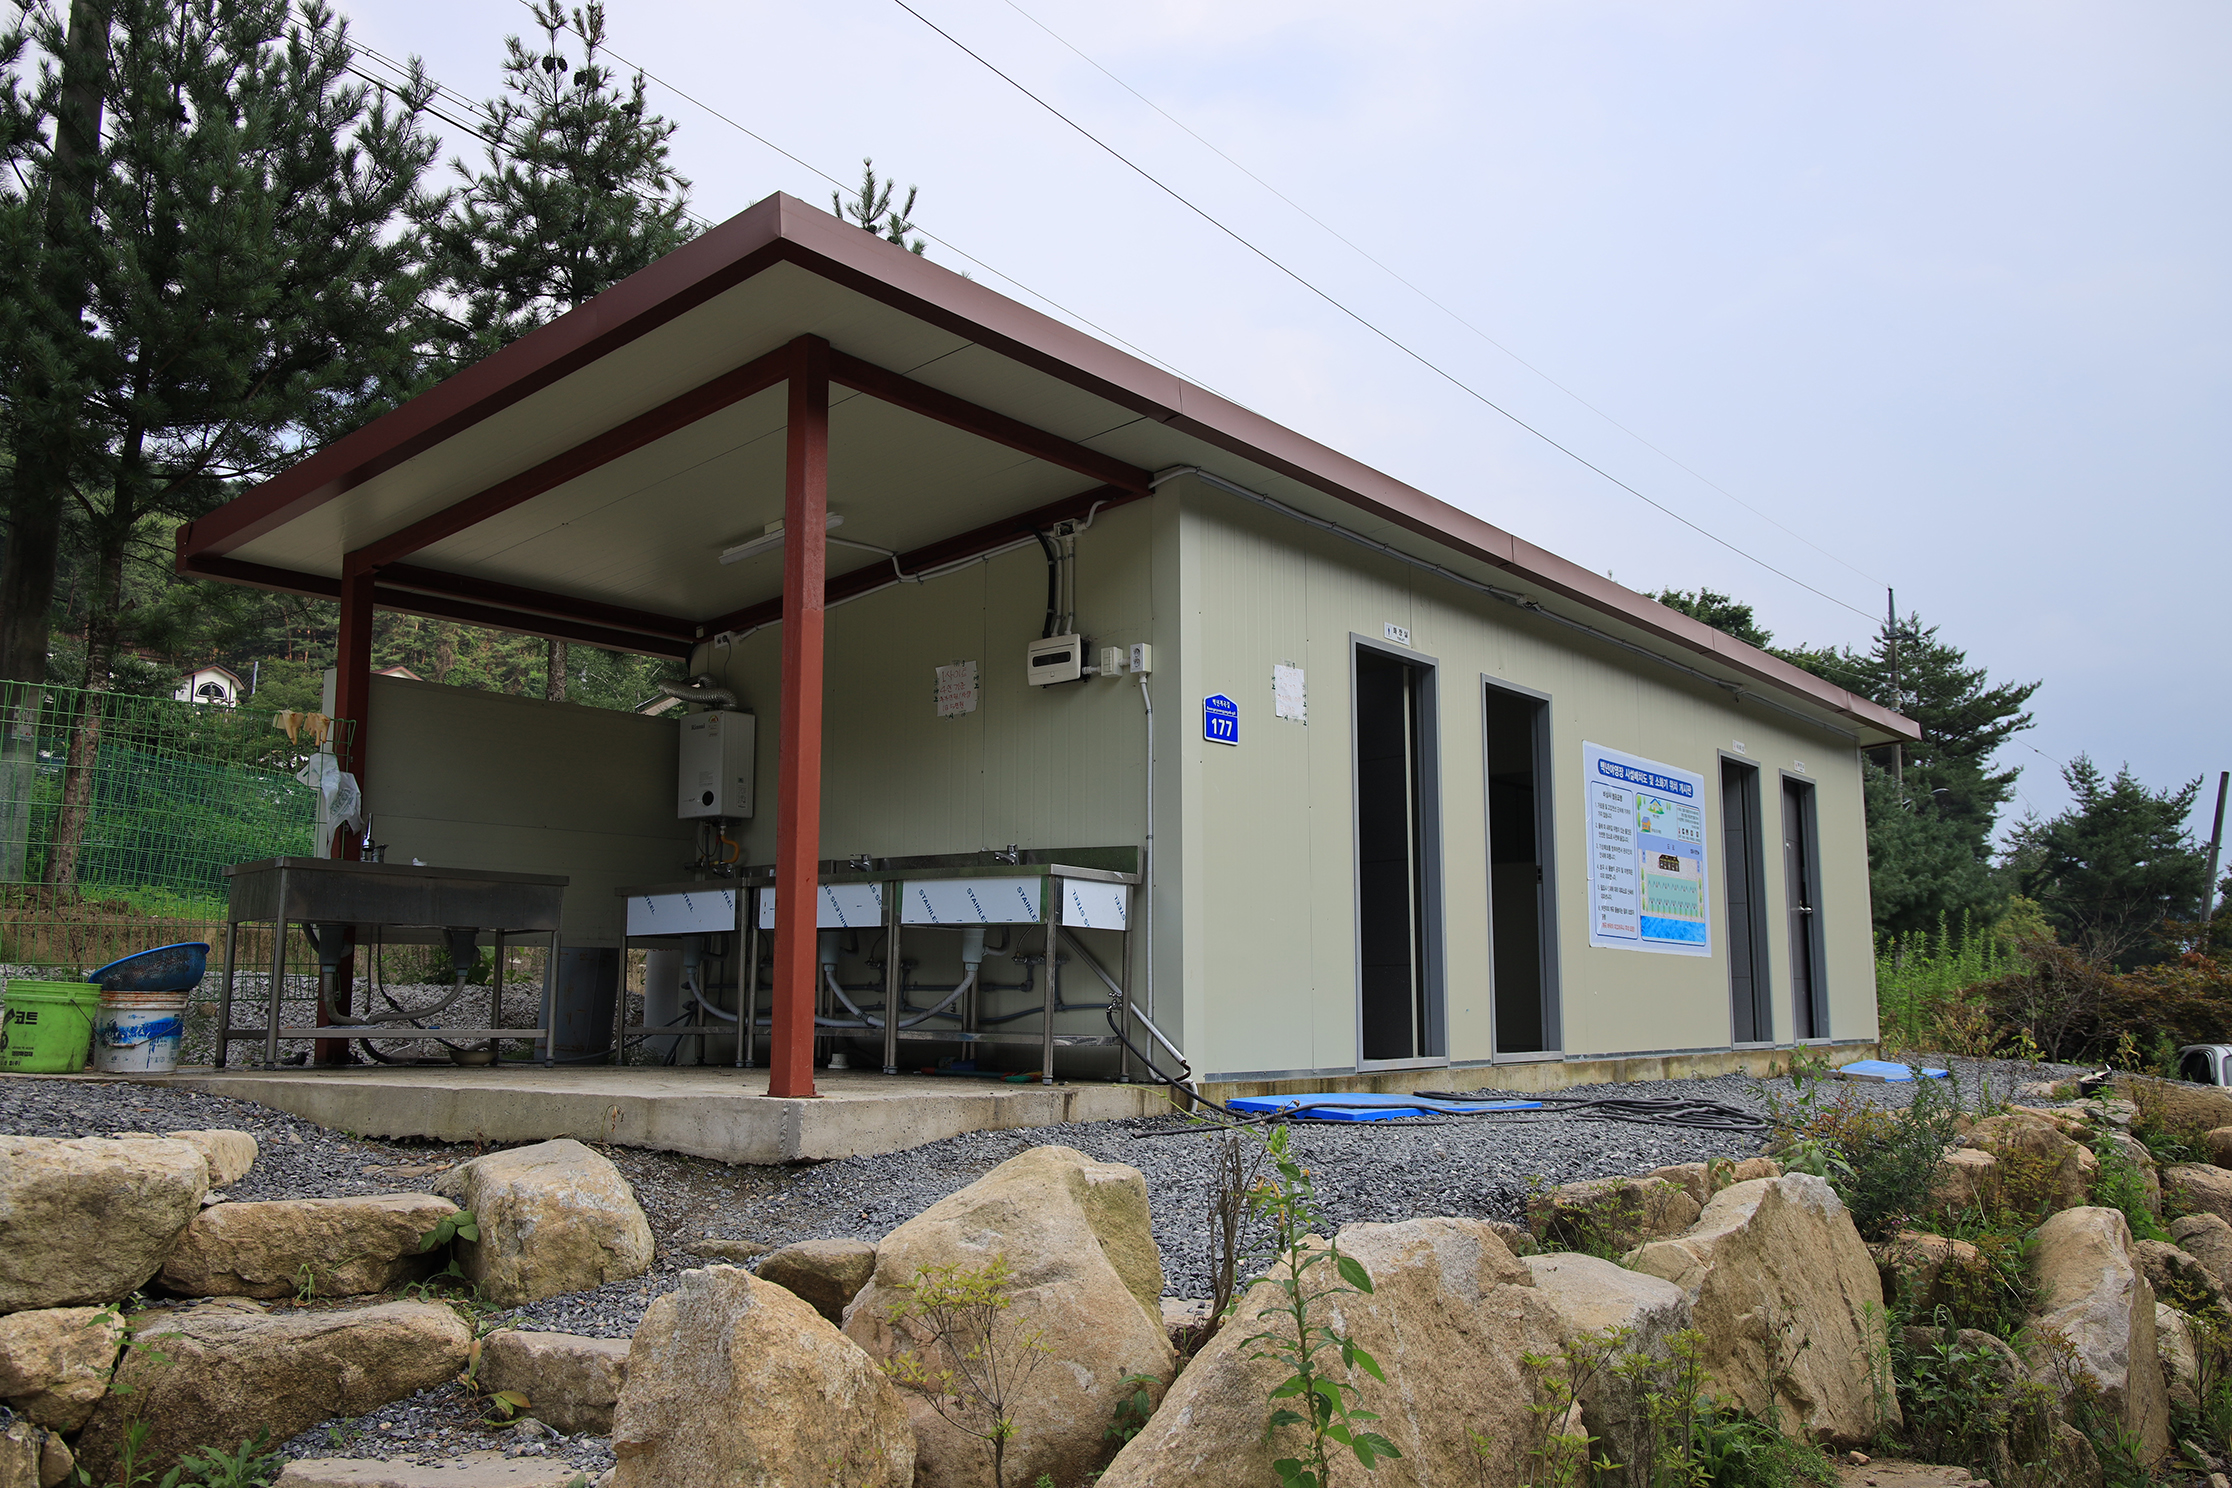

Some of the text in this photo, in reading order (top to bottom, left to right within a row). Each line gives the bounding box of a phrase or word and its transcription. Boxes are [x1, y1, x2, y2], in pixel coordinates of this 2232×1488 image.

[1211, 717, 1233, 737] 177
[1648, 774, 1655, 786] 및
[1655, 775, 1669, 790] 소화기
[1072, 888, 1085, 917] STEEL
[14, 1010, 38, 1025] 코트
